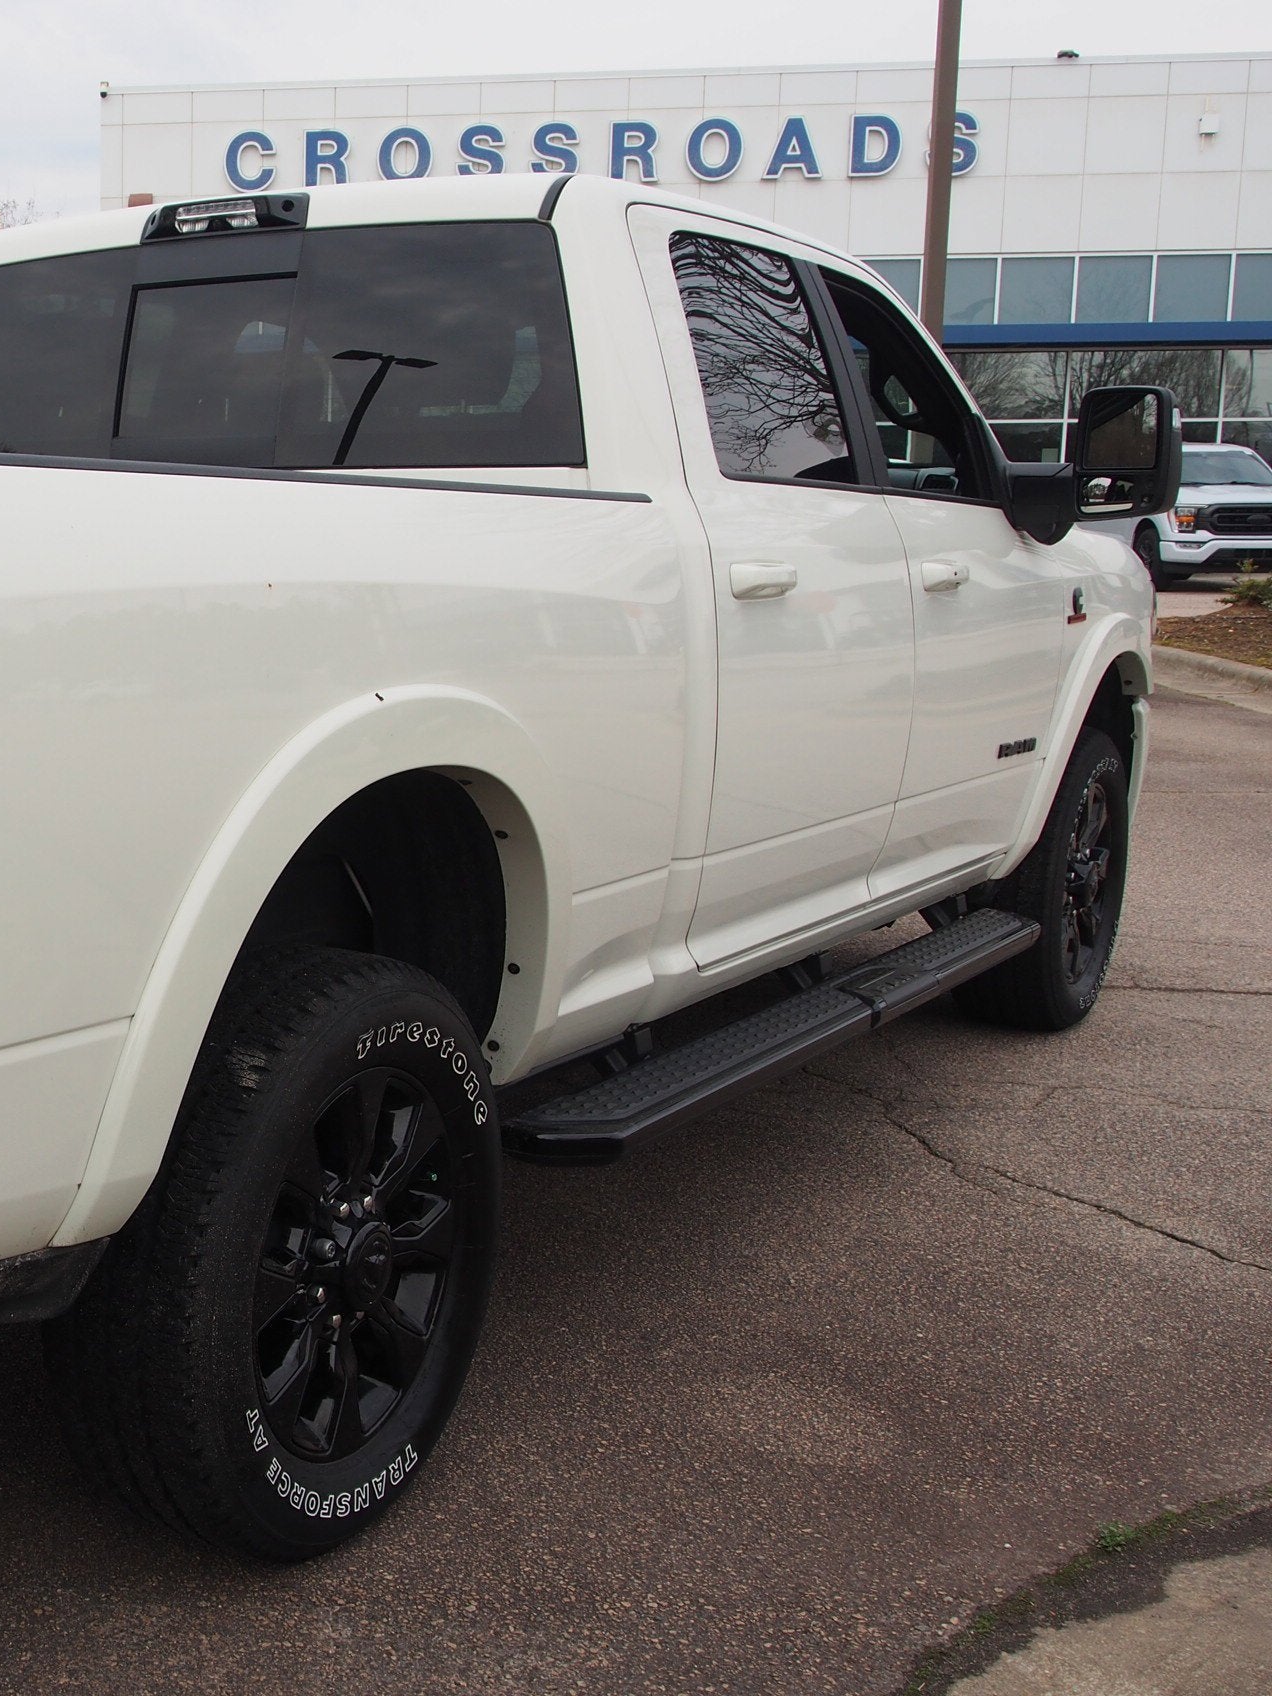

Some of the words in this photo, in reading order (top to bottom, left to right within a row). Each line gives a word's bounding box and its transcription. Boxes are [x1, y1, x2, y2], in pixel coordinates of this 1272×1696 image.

[223, 109, 980, 193] CROSSROADS
[997, 737, 1037, 759] RAM
[356, 1021, 489, 1126] Firestone
[245, 1408, 270, 1453] AT
[266, 1443, 419, 1519] TRANSFORCE
